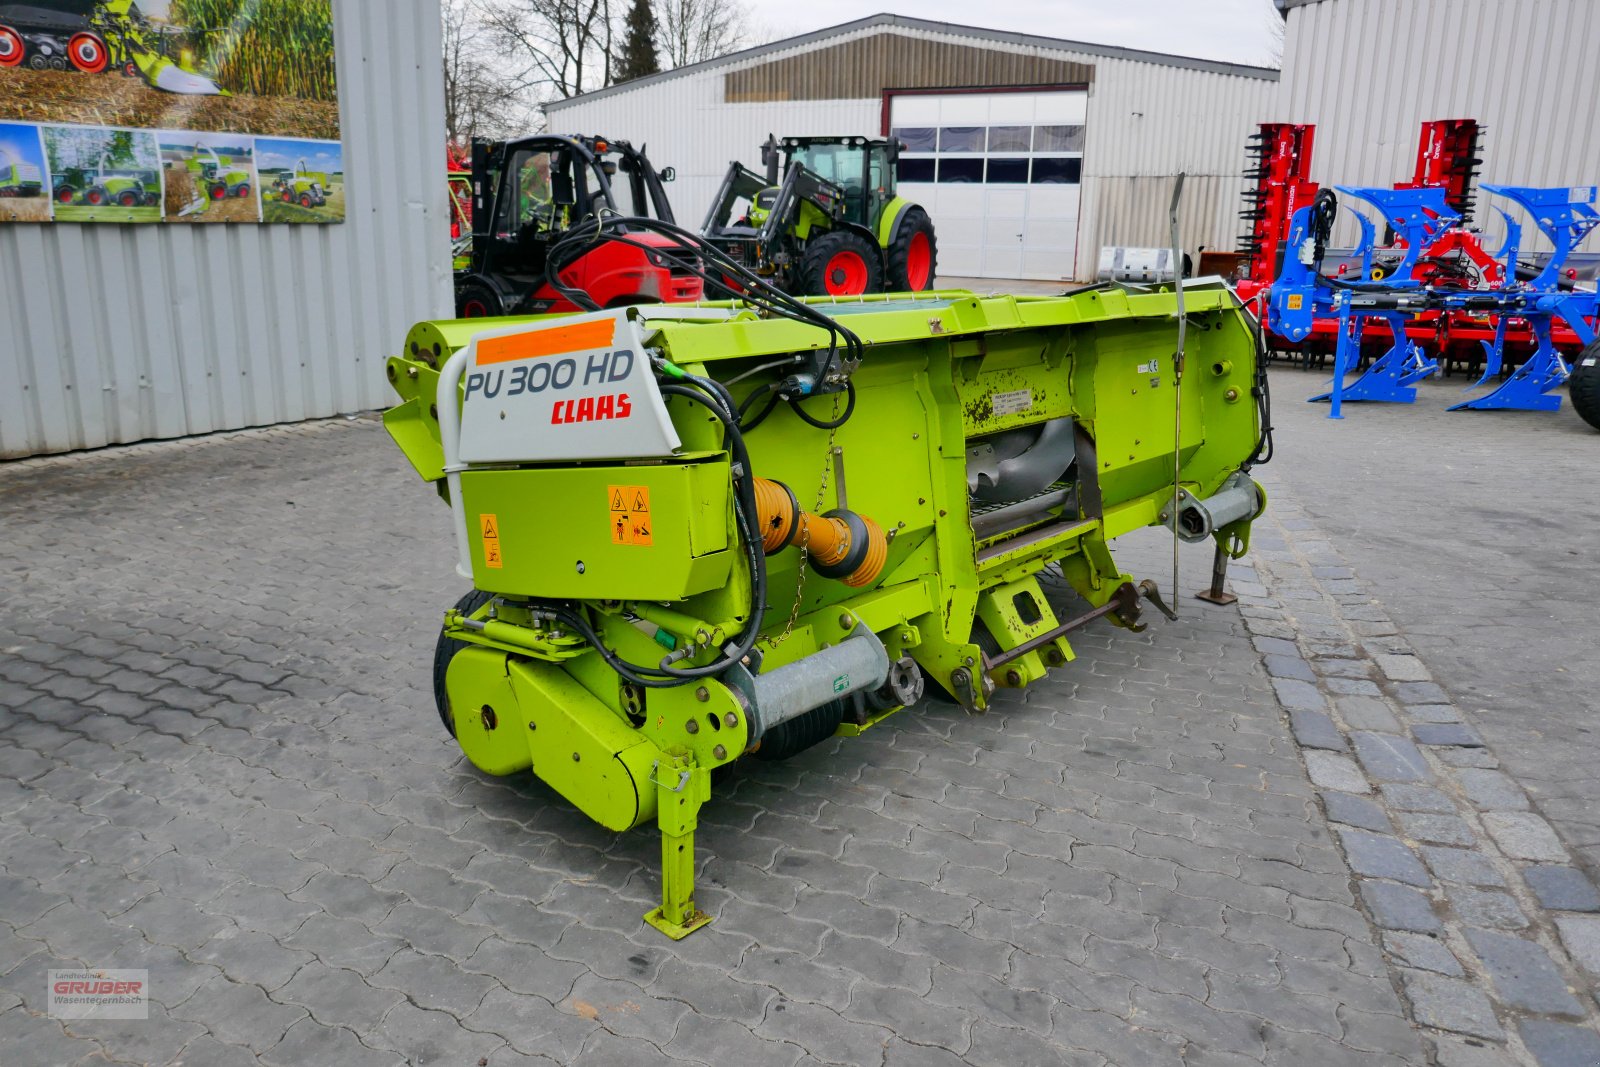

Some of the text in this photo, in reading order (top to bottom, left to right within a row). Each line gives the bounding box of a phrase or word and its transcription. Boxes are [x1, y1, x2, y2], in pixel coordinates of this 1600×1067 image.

[464, 349, 634, 402] PU 300 HD
[550, 393, 632, 425] CLAAS
